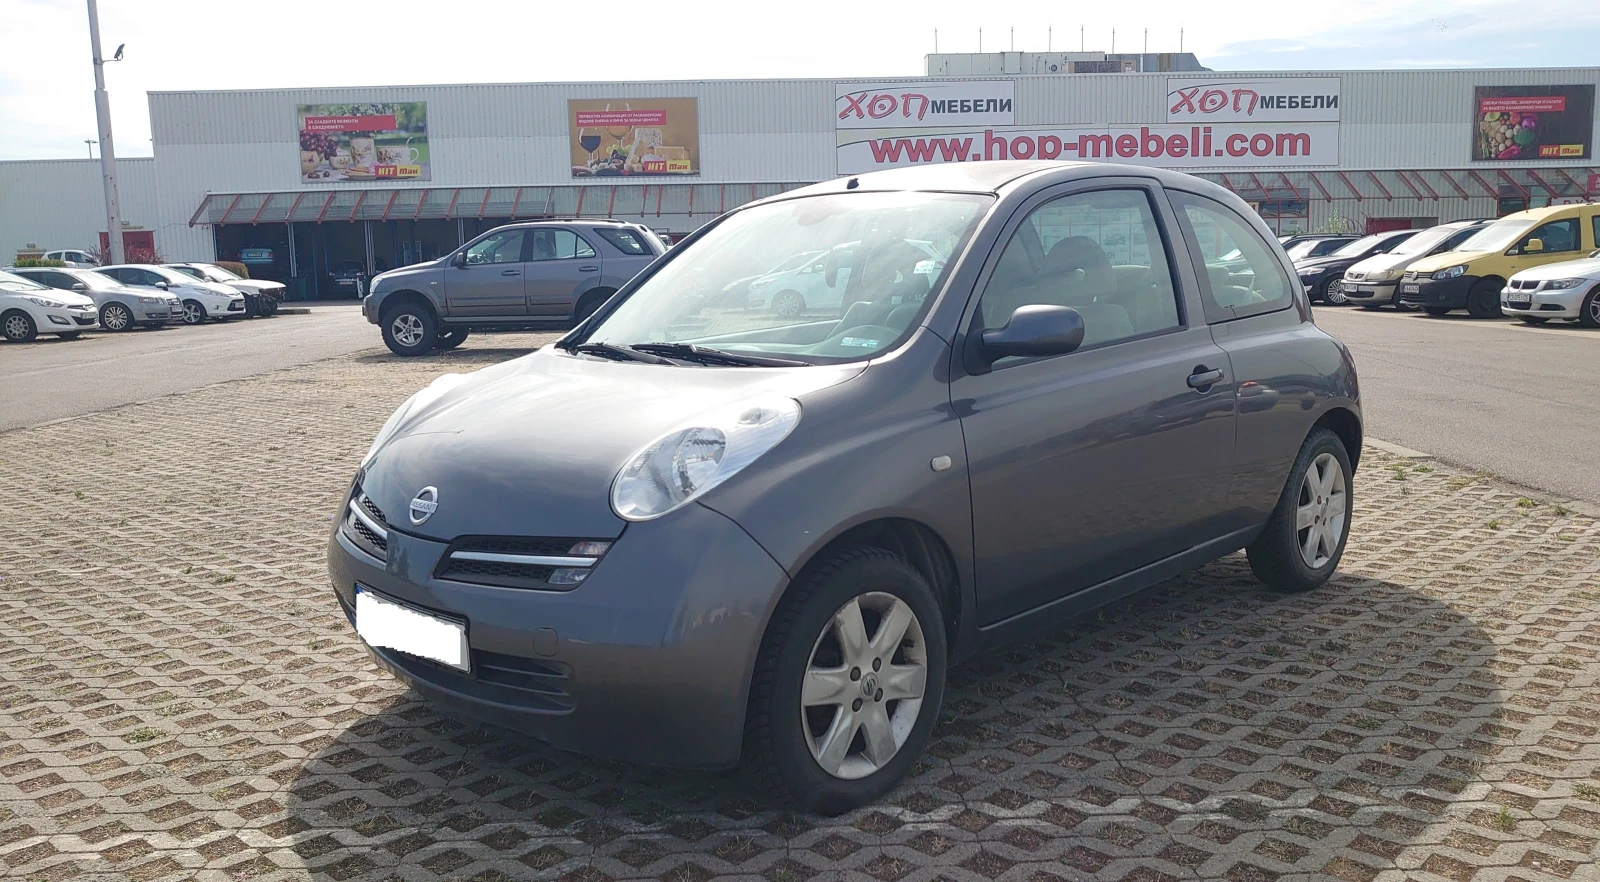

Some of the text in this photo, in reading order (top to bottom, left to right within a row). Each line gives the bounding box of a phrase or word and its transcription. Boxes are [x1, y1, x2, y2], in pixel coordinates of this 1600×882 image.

[838, 91, 1012, 121] ХОП МЕБЕЛИ
[1170, 87, 1339, 116] ХОП МЕБЕЛИ
[868, 126, 1311, 163] www.hop-mebeli.com
[1542, 147, 1559, 155] HIT
[378, 167, 395, 175] HIT
[647, 162, 665, 170] HIT
